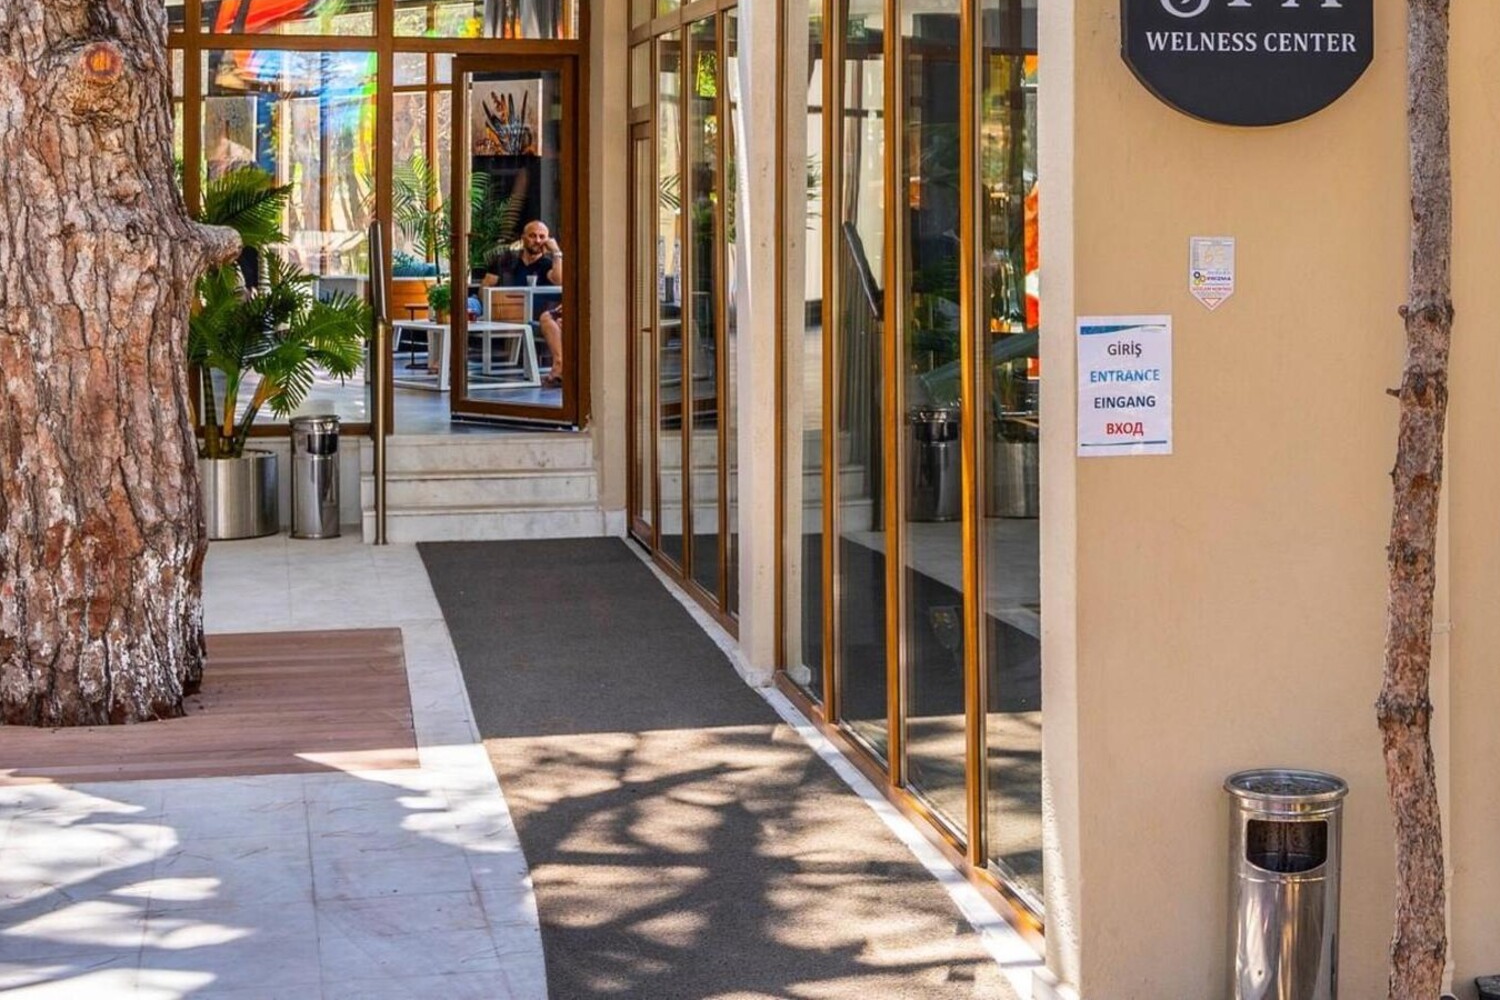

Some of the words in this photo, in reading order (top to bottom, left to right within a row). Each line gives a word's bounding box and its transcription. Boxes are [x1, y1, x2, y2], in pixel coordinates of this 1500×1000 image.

[1145, 31, 1257, 53] WELNESS
[1263, 32, 1357, 53] CENTER
[1107, 340, 1142, 358] GİRİŞ
[1090, 368, 1161, 383] ENTRANCE
[1094, 395, 1157, 409] EINGANG
[1106, 421, 1144, 437] ВХОД
